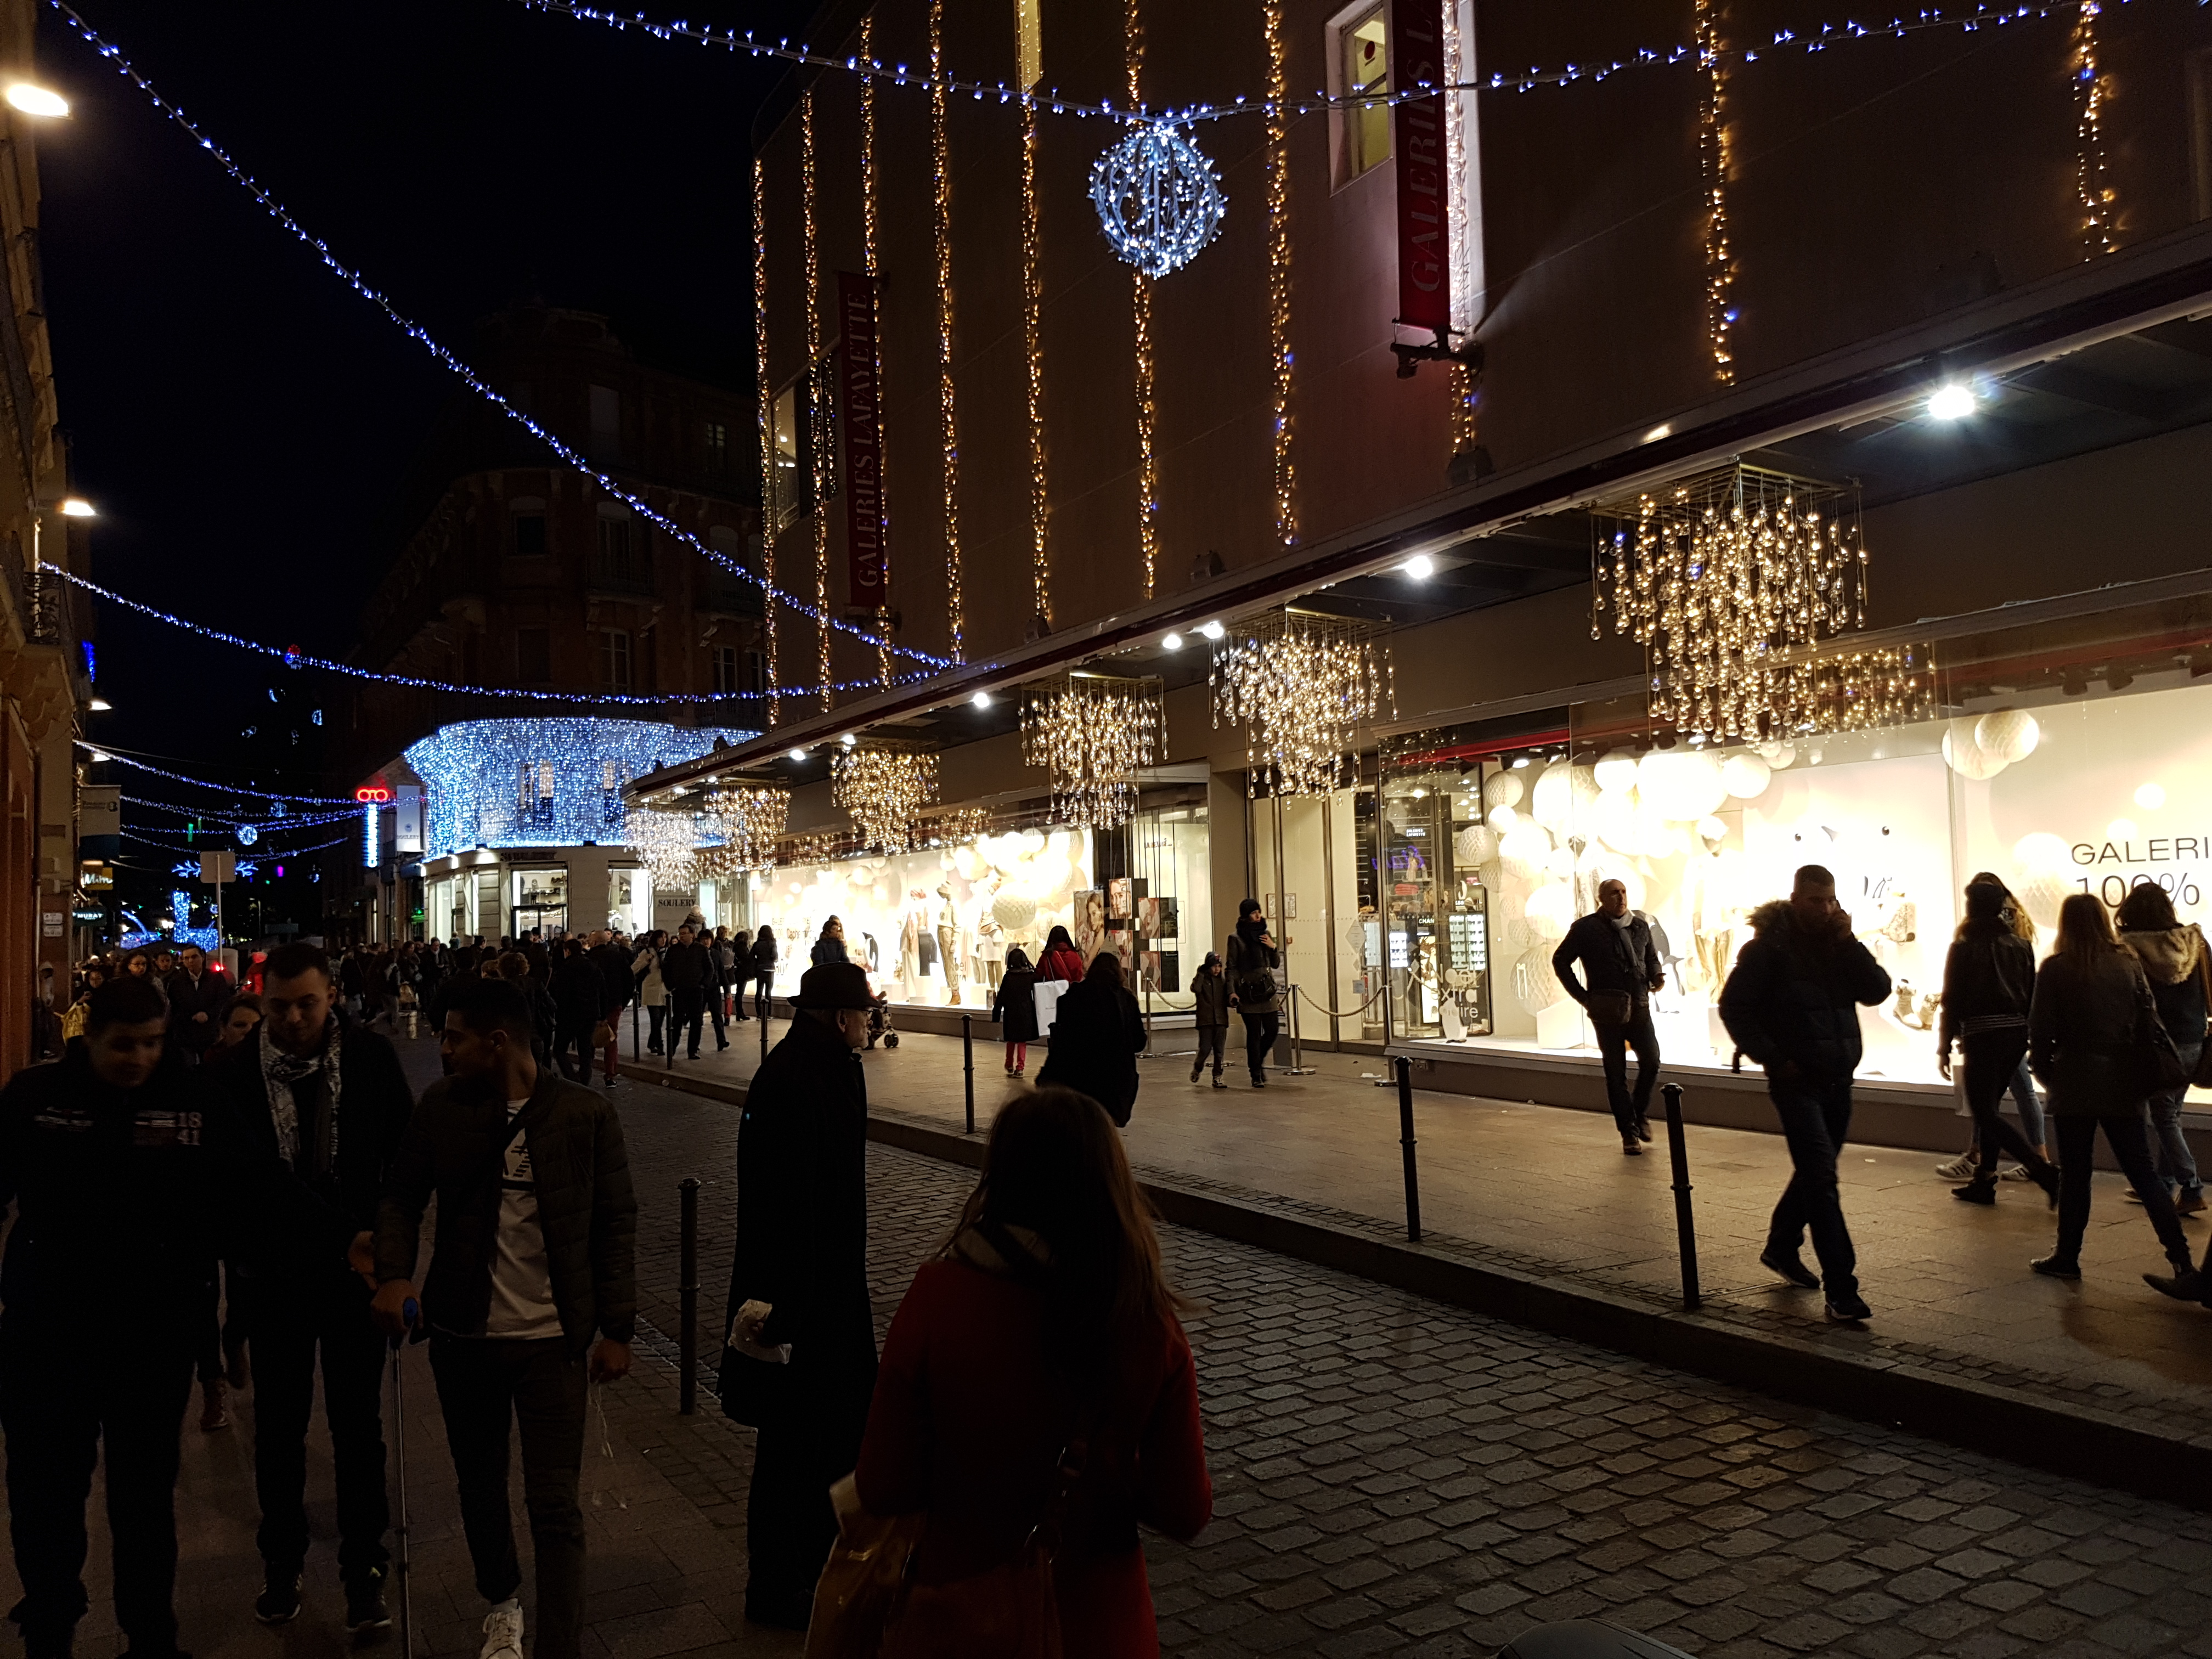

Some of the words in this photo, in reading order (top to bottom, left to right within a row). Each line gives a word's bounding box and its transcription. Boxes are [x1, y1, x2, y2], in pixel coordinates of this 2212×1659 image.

[848, 293, 872, 445] LAFAYETTE
[854, 455, 878, 587] GALERIES
[2071, 837, 2209, 865] GALERI
[177, 1111, 203, 1128] 18
